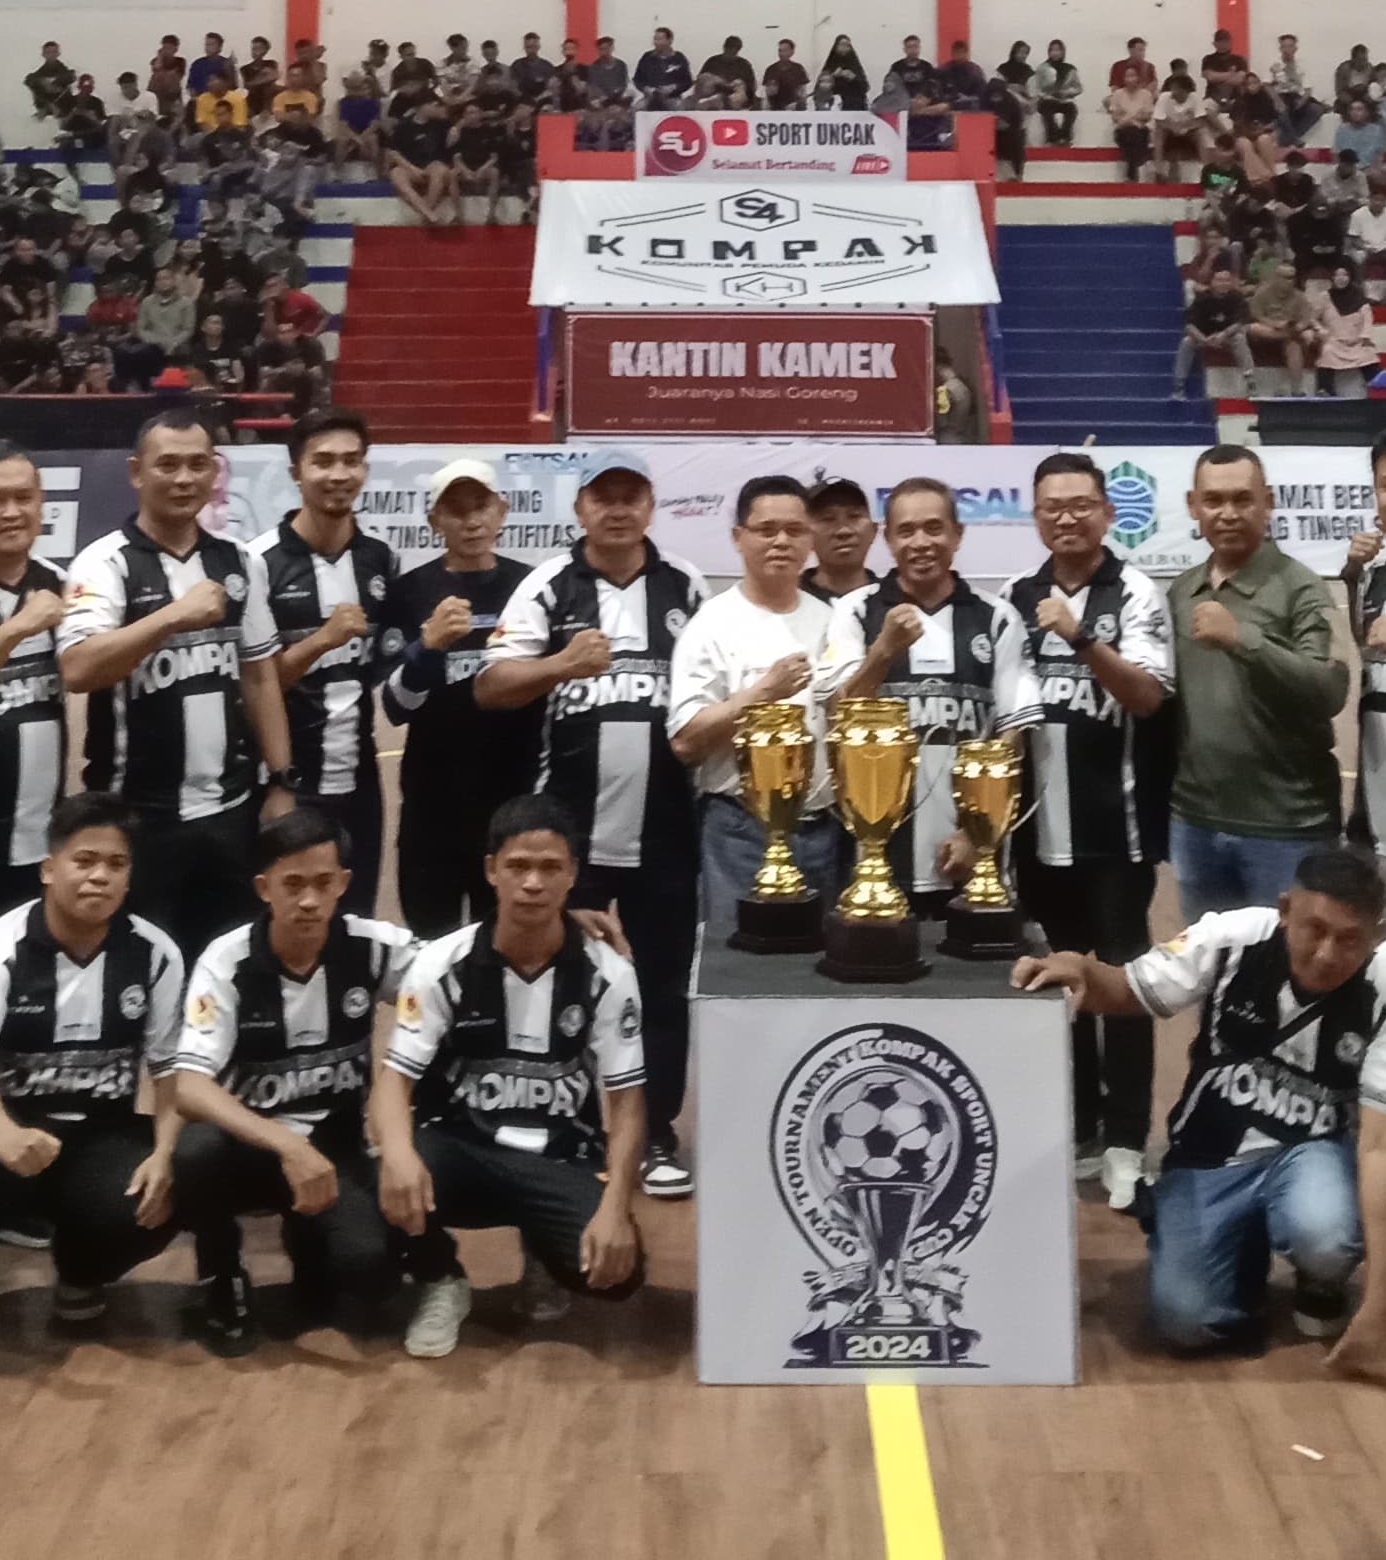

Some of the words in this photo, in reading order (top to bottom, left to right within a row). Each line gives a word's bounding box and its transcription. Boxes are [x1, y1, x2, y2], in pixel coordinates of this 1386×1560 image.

[756, 123, 812, 145] SPORT
[817, 123, 875, 145] UNCAK
[586, 233, 938, 260] KOMPAK
[609, 342, 746, 377] KANTIN
[759, 342, 897, 378] KAMEK
[647, 386, 735, 402] Juaranya
[740, 386, 781, 399] Nasi
[787, 386, 859, 402] Goreng
[876, 487, 1030, 519] FSAL
[845, 1334, 932, 1358] 2024
